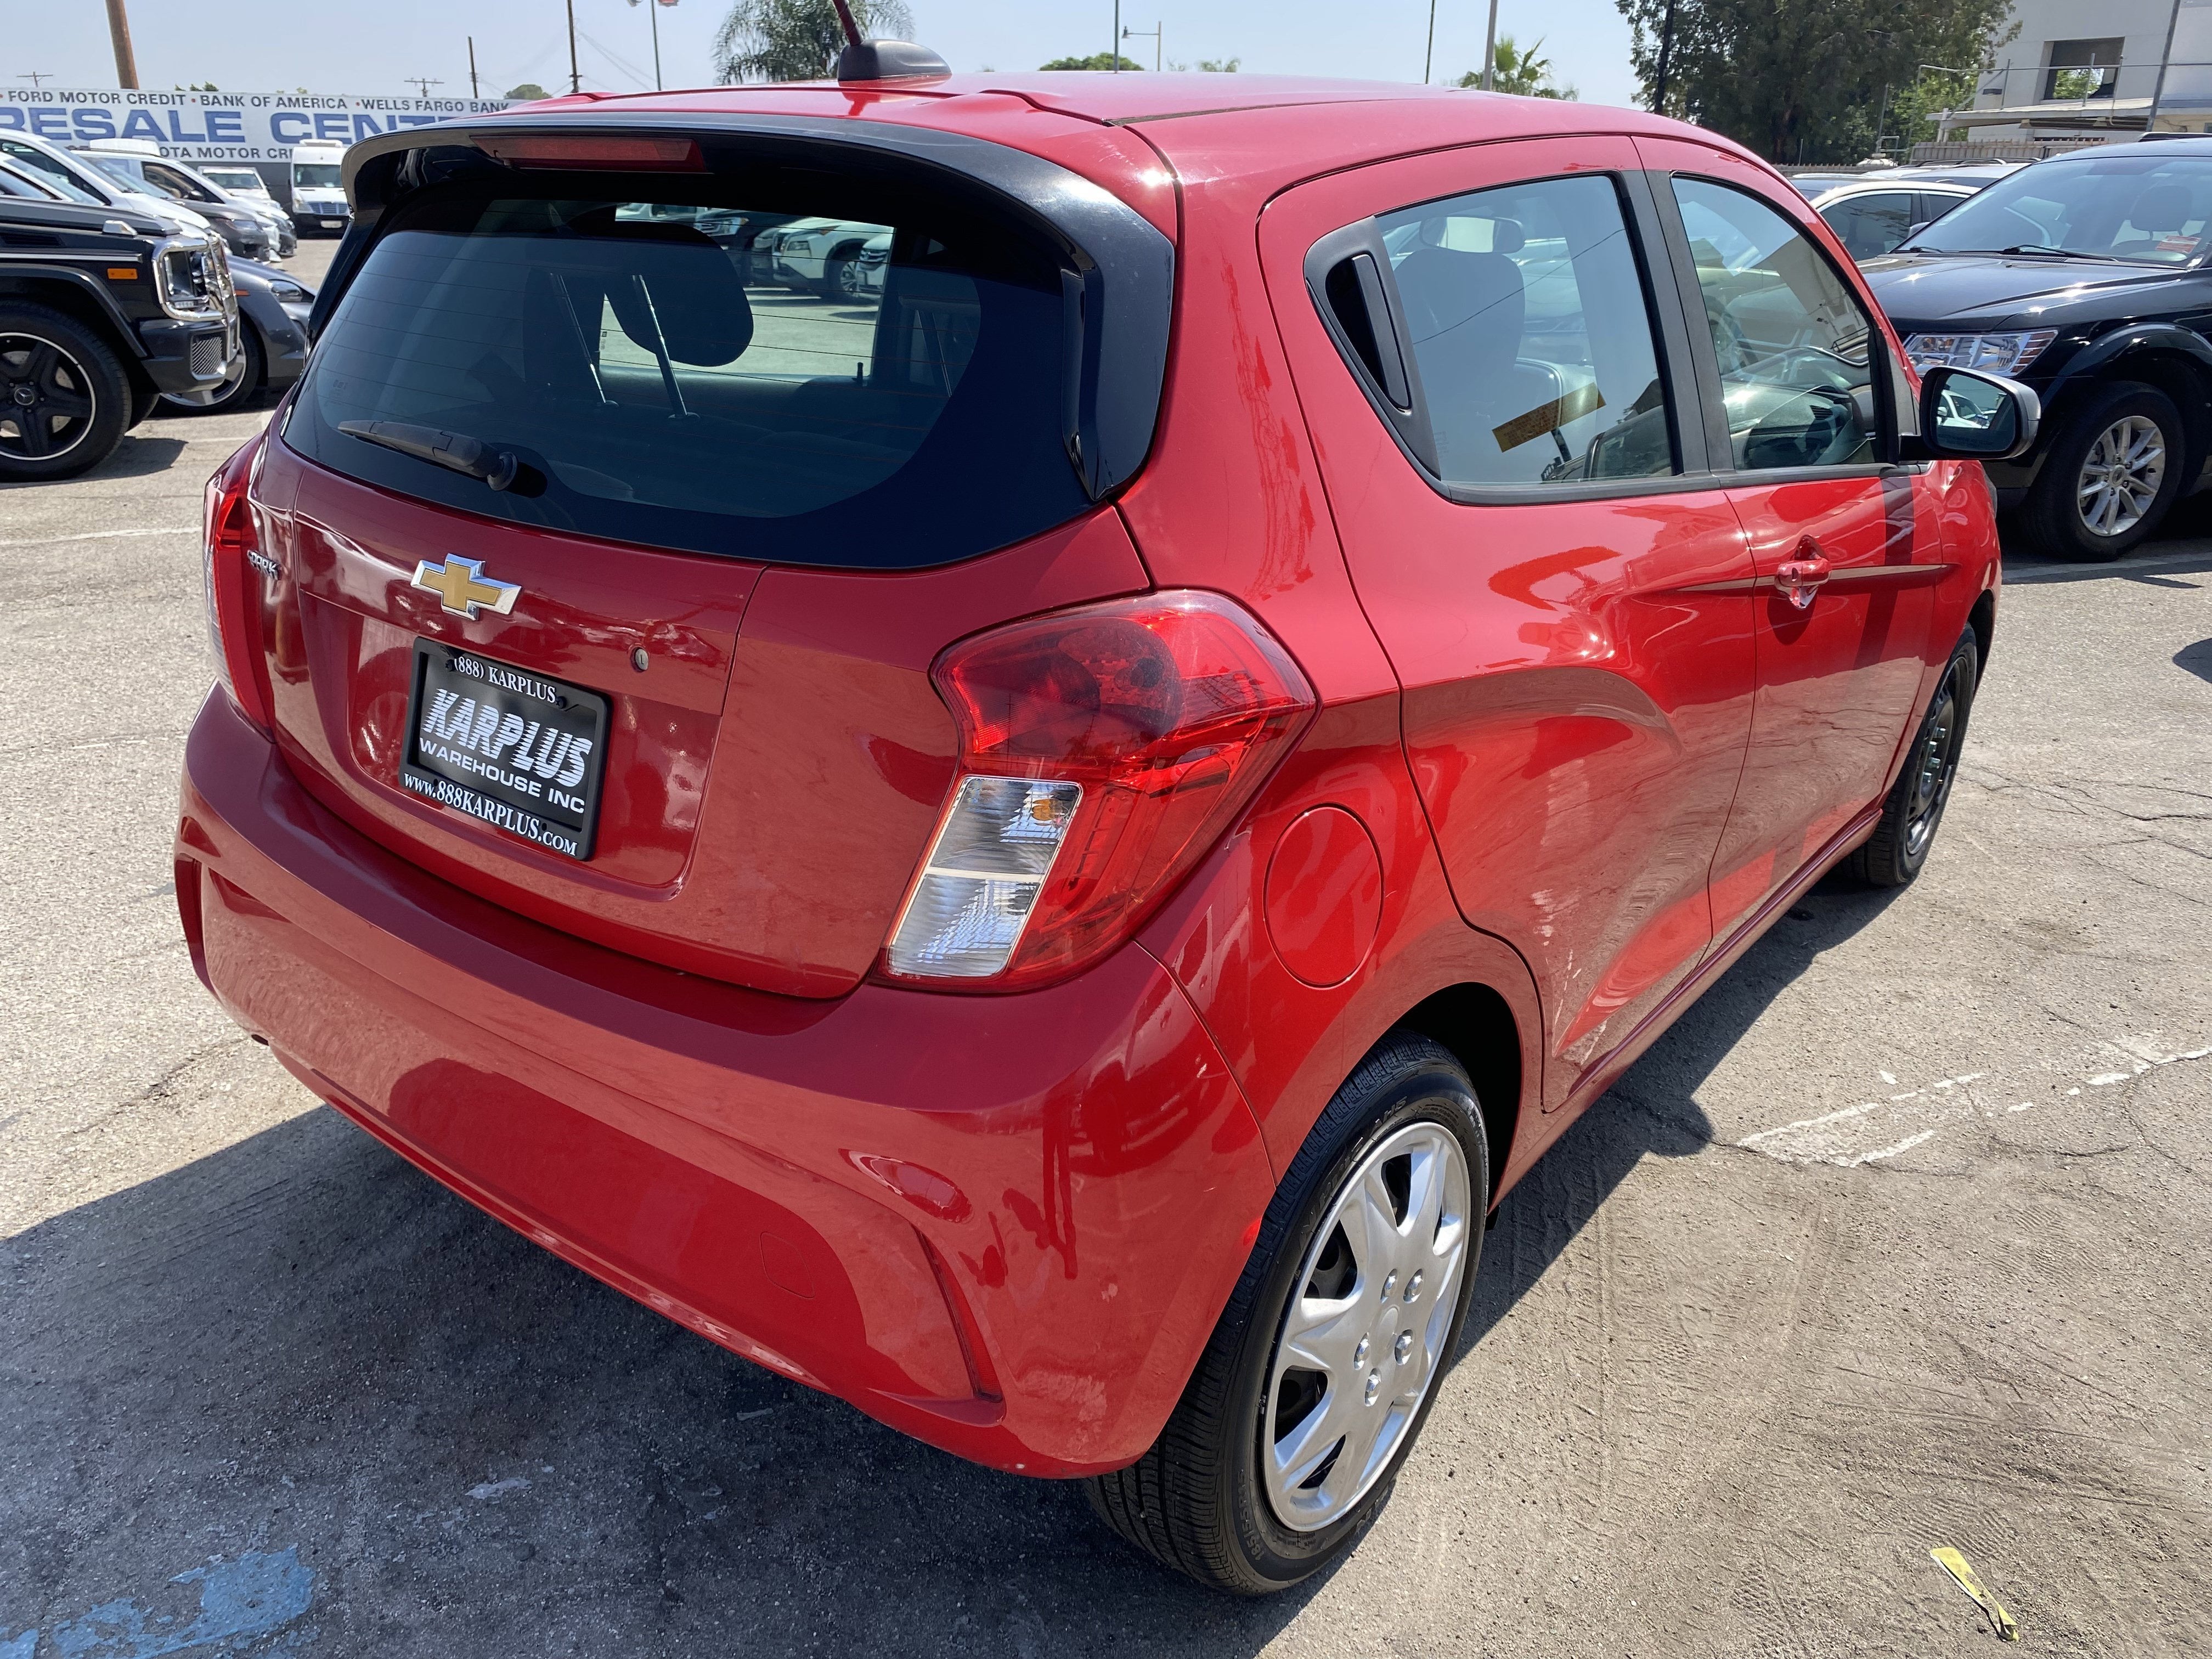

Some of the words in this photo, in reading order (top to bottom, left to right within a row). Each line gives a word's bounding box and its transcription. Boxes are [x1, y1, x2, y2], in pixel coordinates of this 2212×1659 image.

[8, 91, 53, 103] FORD
[59, 92, 121, 104] MOTOR
[127, 93, 186, 105] CREDIT
[200, 95, 245, 106] BANK
[251, 96, 270, 107] OF
[275, 97, 347, 109] AMERICA
[361, 99, 410, 110] WELLS
[415, 100, 464, 111] FARGO
[470, 101, 509, 113] BANK
[197, 147, 261, 159] MOTOR
[454, 656, 484, 679] (888)
[488, 665, 557, 703] KARPLUS
[421, 688, 593, 787] KARPLUS
[419, 737, 542, 798] WAREHOUSE
[548, 788, 585, 814] INC
